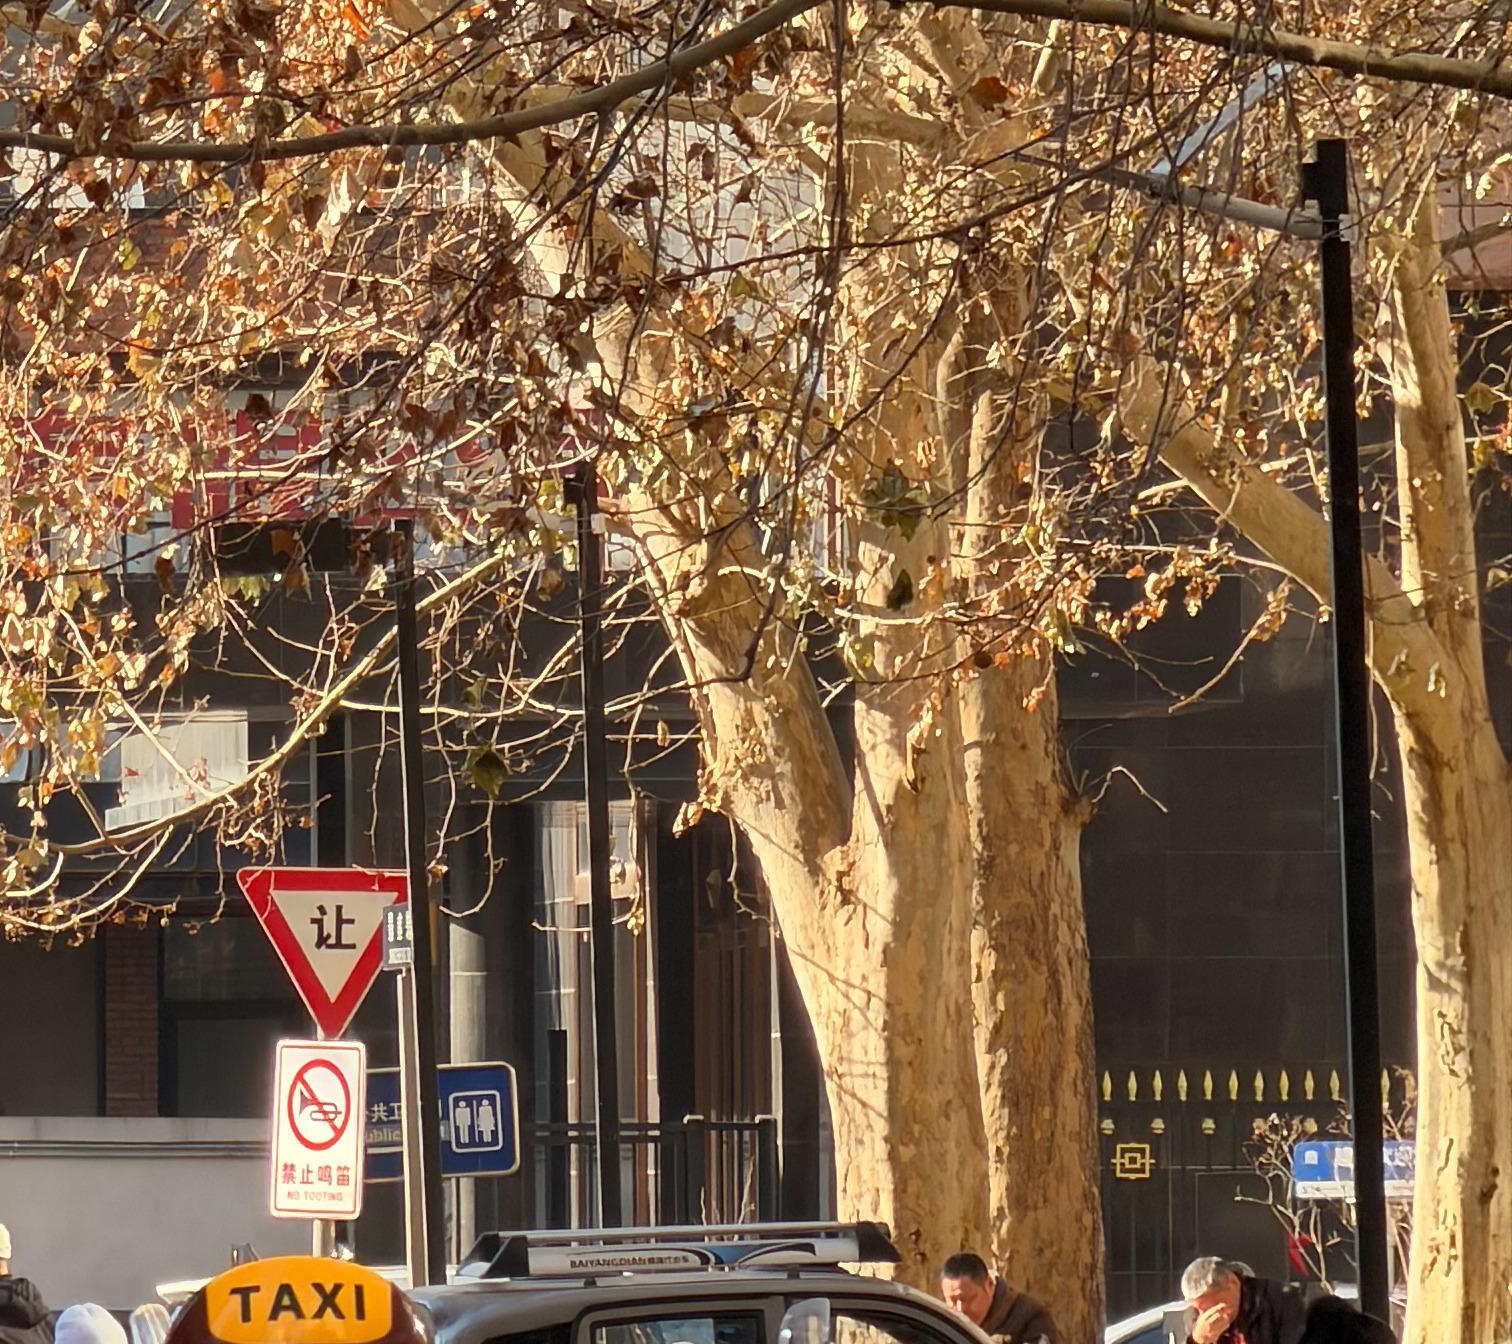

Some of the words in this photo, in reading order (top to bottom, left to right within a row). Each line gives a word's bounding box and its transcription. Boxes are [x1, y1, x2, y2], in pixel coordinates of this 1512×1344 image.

[310, 904, 357, 951] 让
[281, 1162, 352, 1187] 禁止鸣笛
[229, 1282, 367, 1325] TAXI
